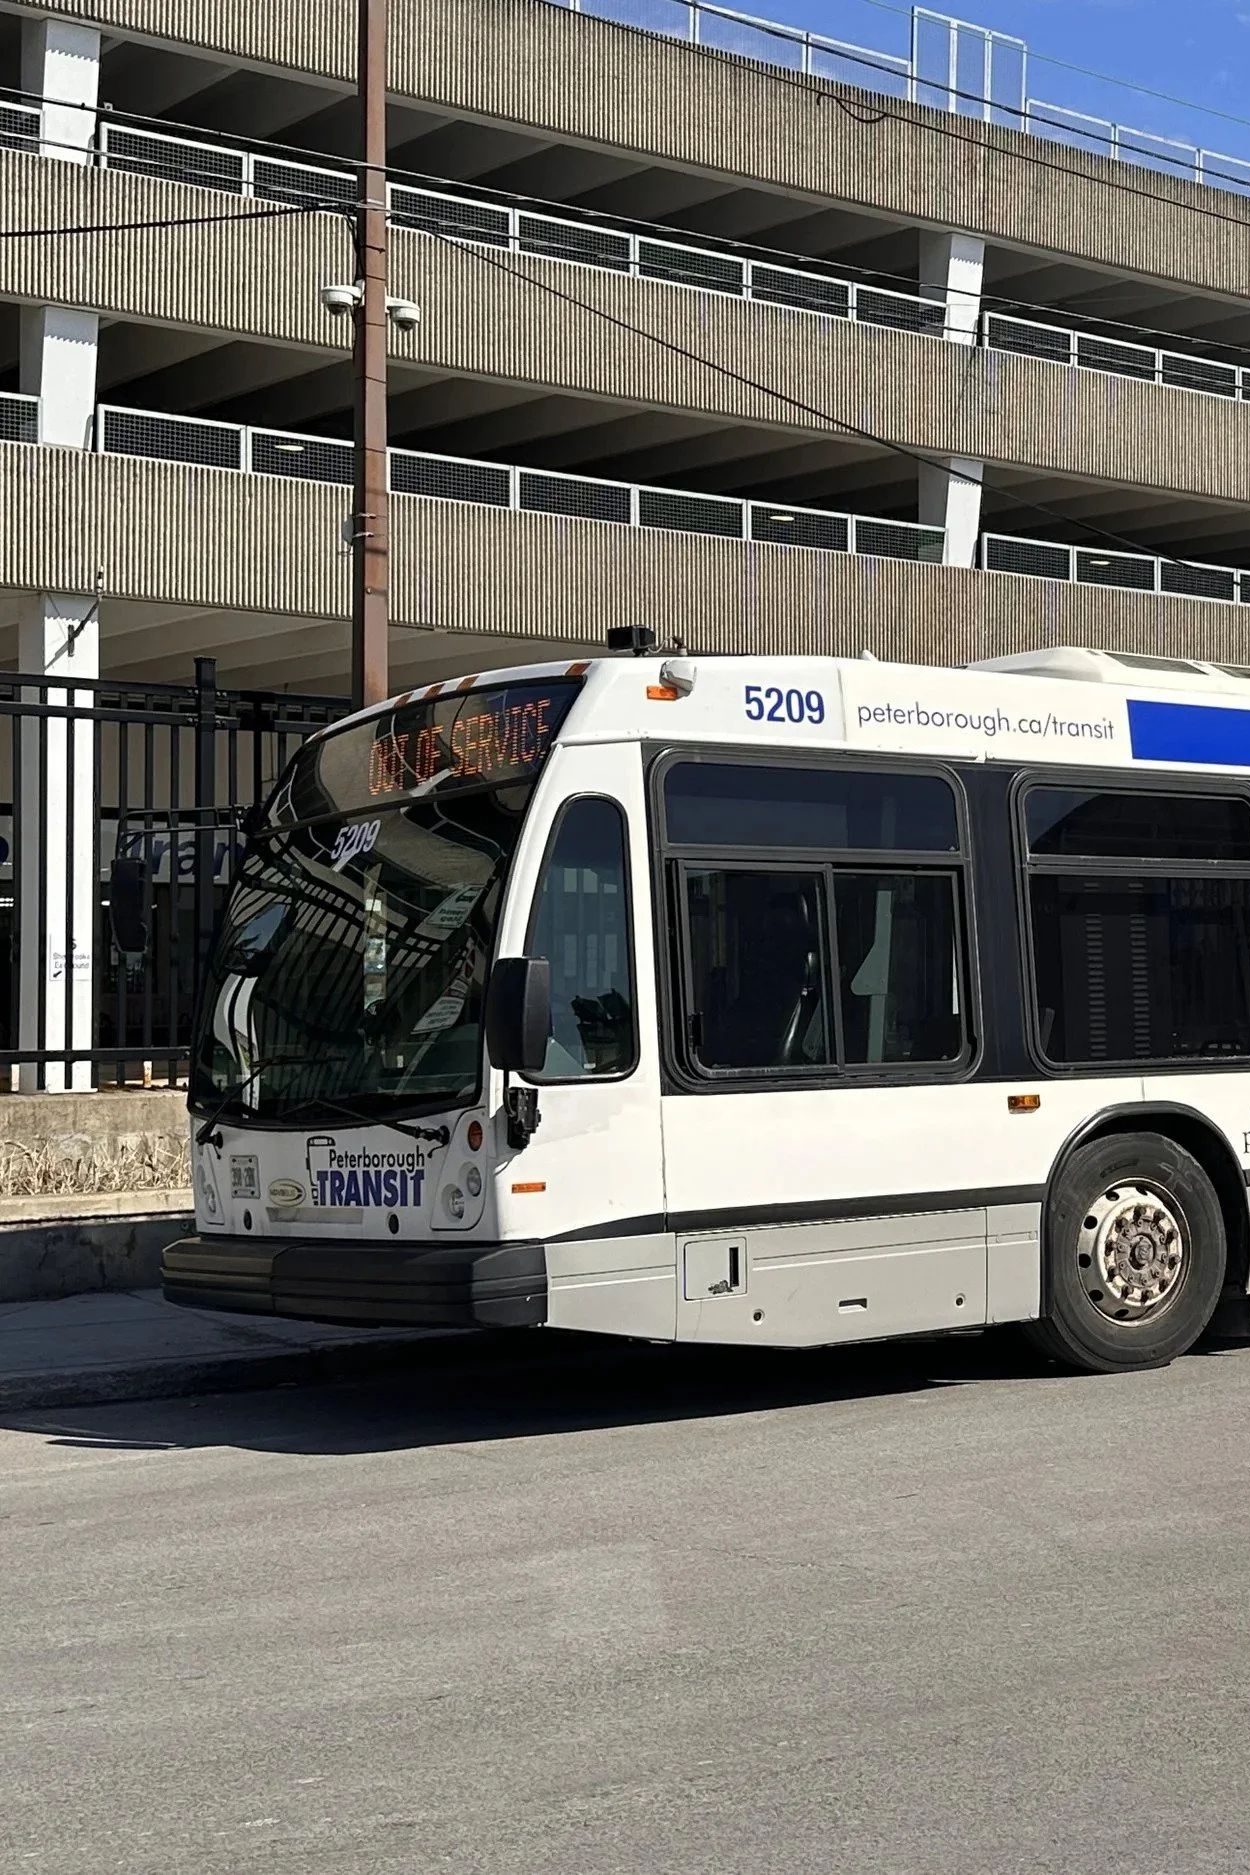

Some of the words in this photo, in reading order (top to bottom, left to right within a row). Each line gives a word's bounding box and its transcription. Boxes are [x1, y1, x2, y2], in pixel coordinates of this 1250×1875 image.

[745, 685, 825, 724] 5209
[858, 702, 1114, 740] peterborough.ca/transit
[369, 734, 409, 796] OUT
[416, 724, 444, 786] OF
[451, 699, 550, 777] SERVICE
[331, 820, 381, 860] 5209
[329, 1144, 425, 1173] Peterborough
[317, 1169, 425, 1207] TRANSIT
